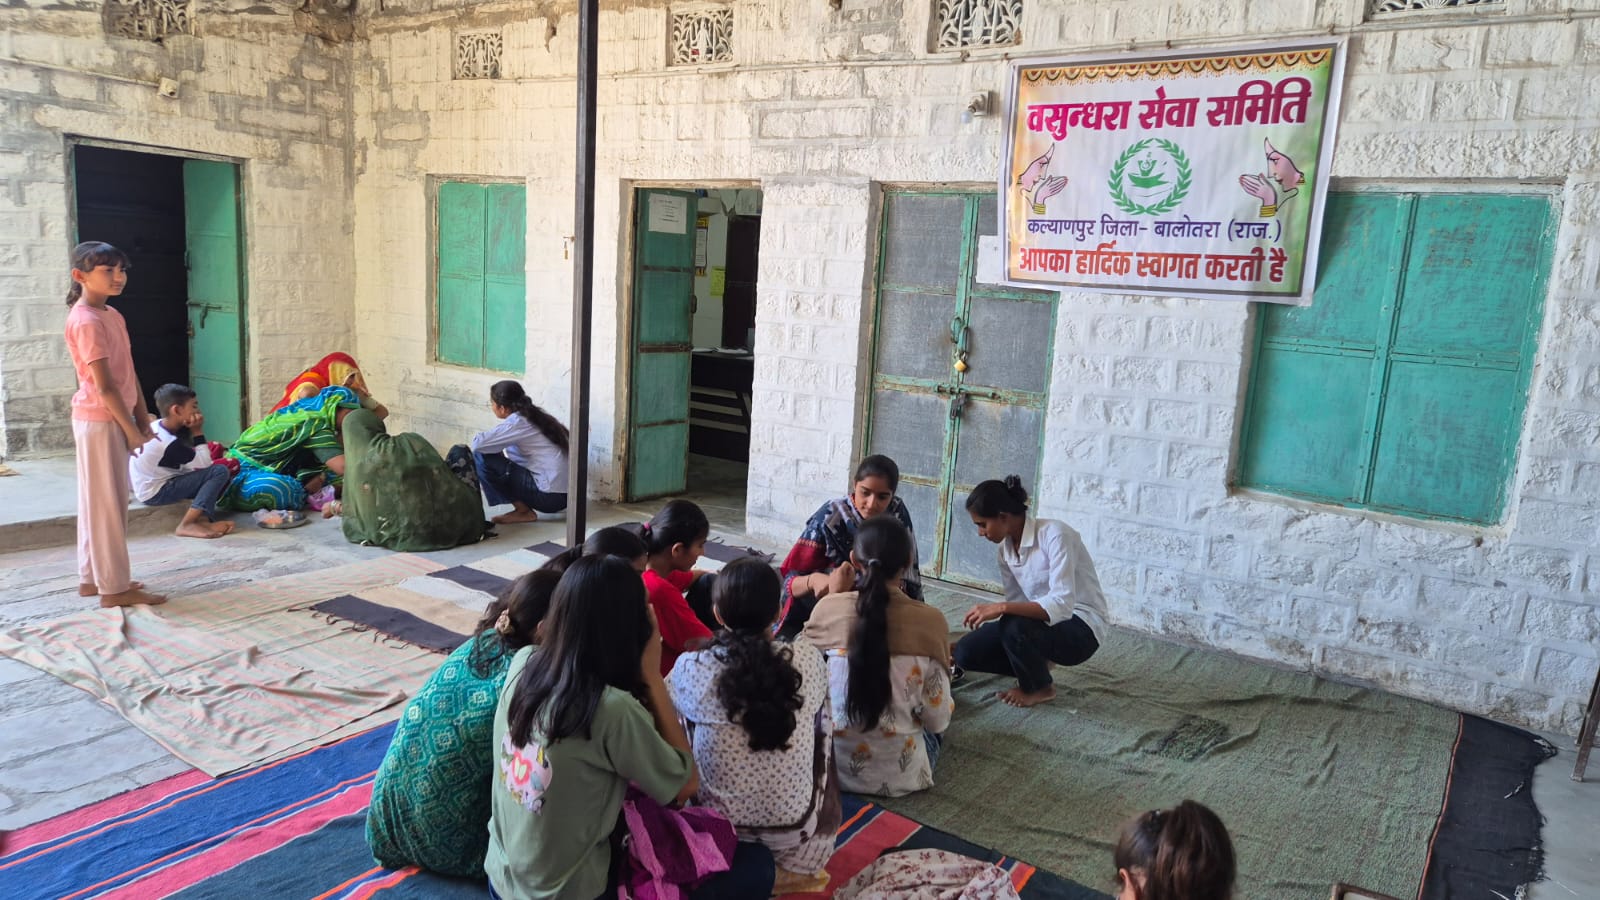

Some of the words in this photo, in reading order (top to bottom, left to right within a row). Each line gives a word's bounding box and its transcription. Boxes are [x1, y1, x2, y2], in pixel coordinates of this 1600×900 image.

[1027, 101, 1132, 141] वसुन्धरा
[1138, 86, 1200, 130] सेवा
[1207, 77, 1312, 126] समिति
[1027, 219, 1096, 241] कल्याणपुर
[1154, 214, 1221, 239] बालोतरा
[1227, 219, 1282, 242] (राज.)
[1019, 247, 1073, 274] आपका
[1075, 240, 1134, 275] हार्दिक
[1136, 251, 1201, 280] स्वागत
[1204, 246, 1266, 282] करती
[1268, 246, 1288, 283] है
